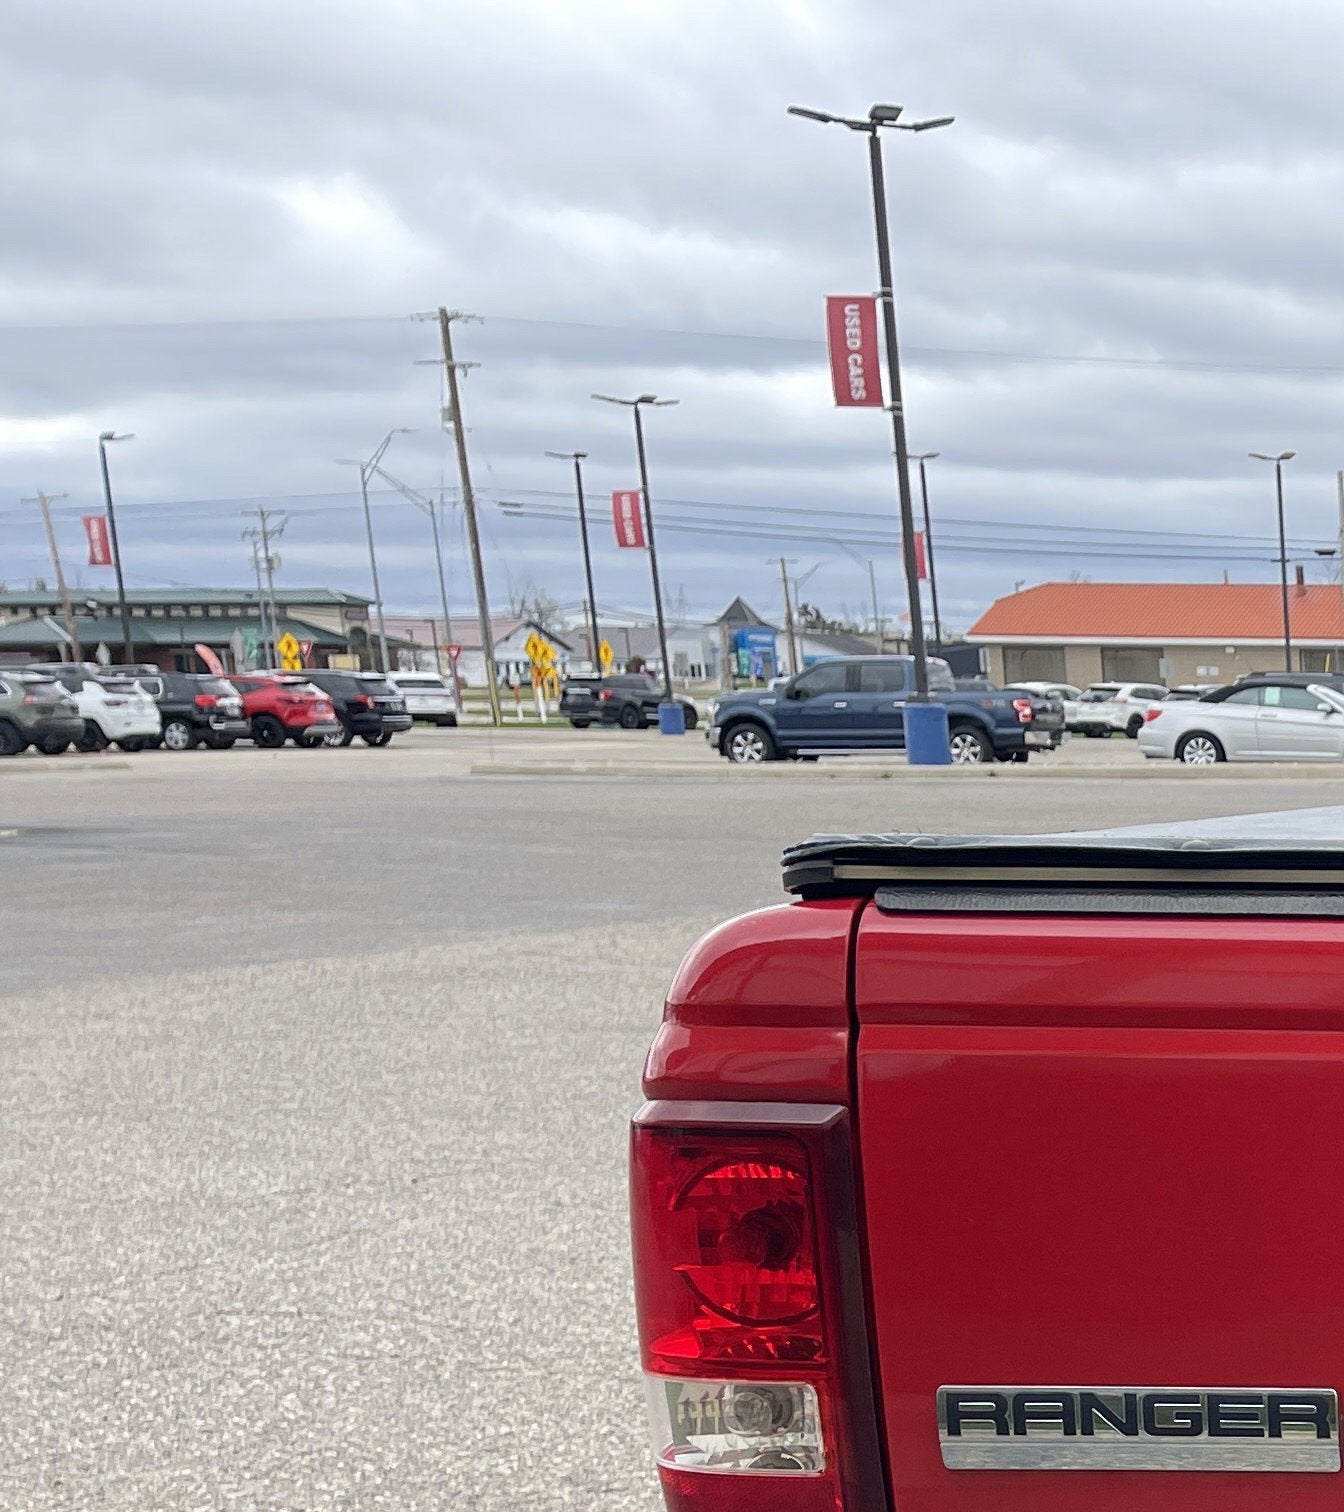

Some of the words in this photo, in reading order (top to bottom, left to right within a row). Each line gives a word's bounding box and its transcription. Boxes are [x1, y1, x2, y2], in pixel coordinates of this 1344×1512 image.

[844, 303, 862, 351] USED
[848, 353, 867, 401] CARS
[946, 1392, 1332, 1439] RANGER
